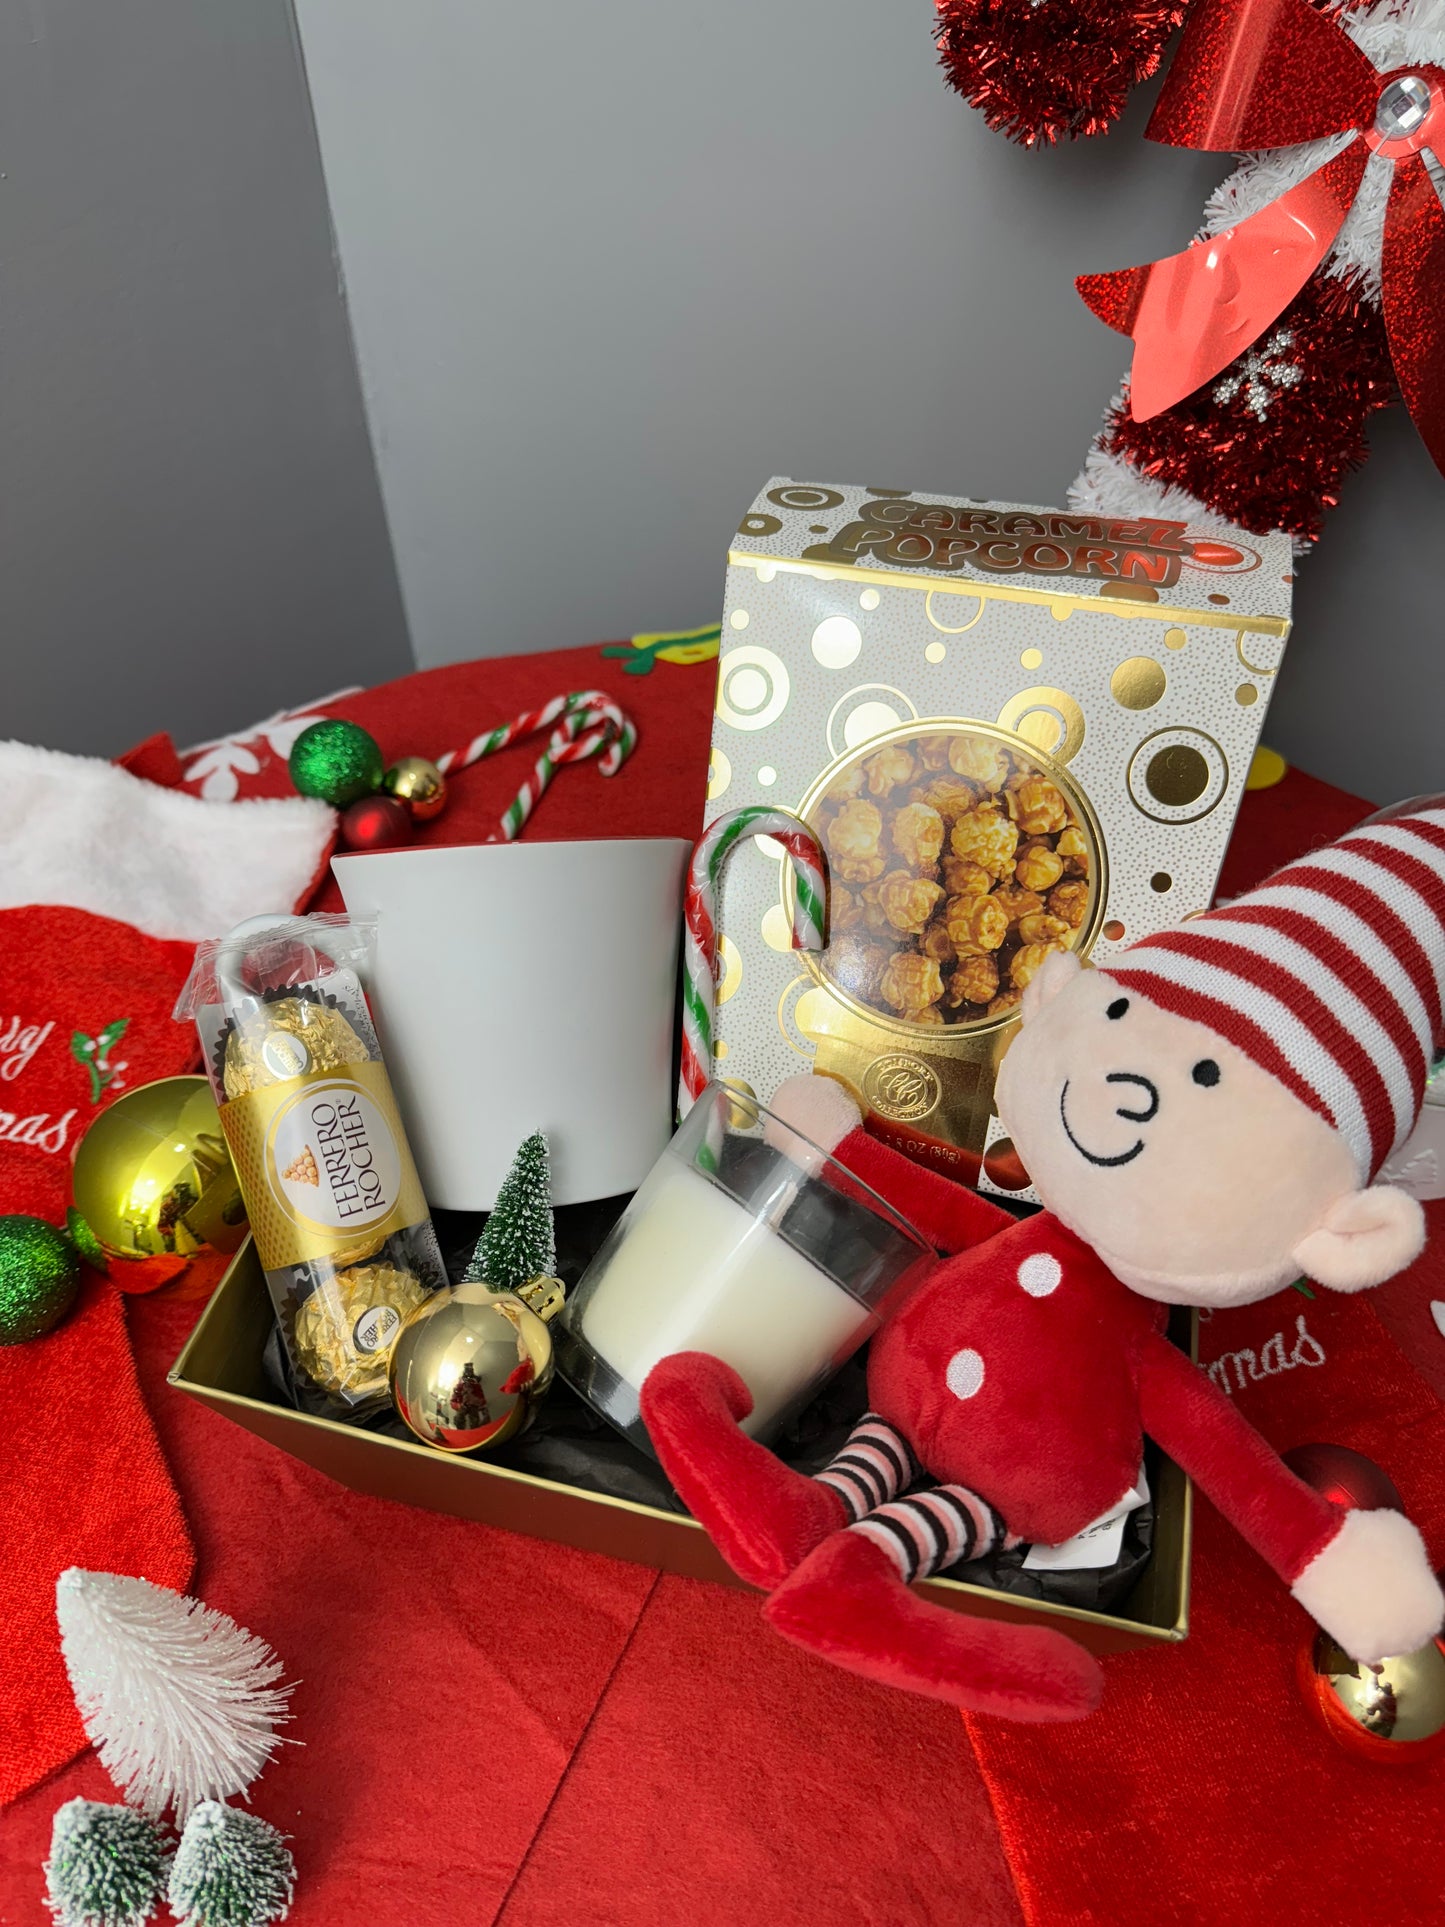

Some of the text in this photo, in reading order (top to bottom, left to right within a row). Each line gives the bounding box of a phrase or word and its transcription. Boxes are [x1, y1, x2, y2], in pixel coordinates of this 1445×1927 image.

[842, 527, 1172, 584] POPCORN
[870, 502, 1187, 551] CARAMEL
[320, 1103, 363, 1219] FERRERO
[340, 1095, 386, 1210] ROCHER
